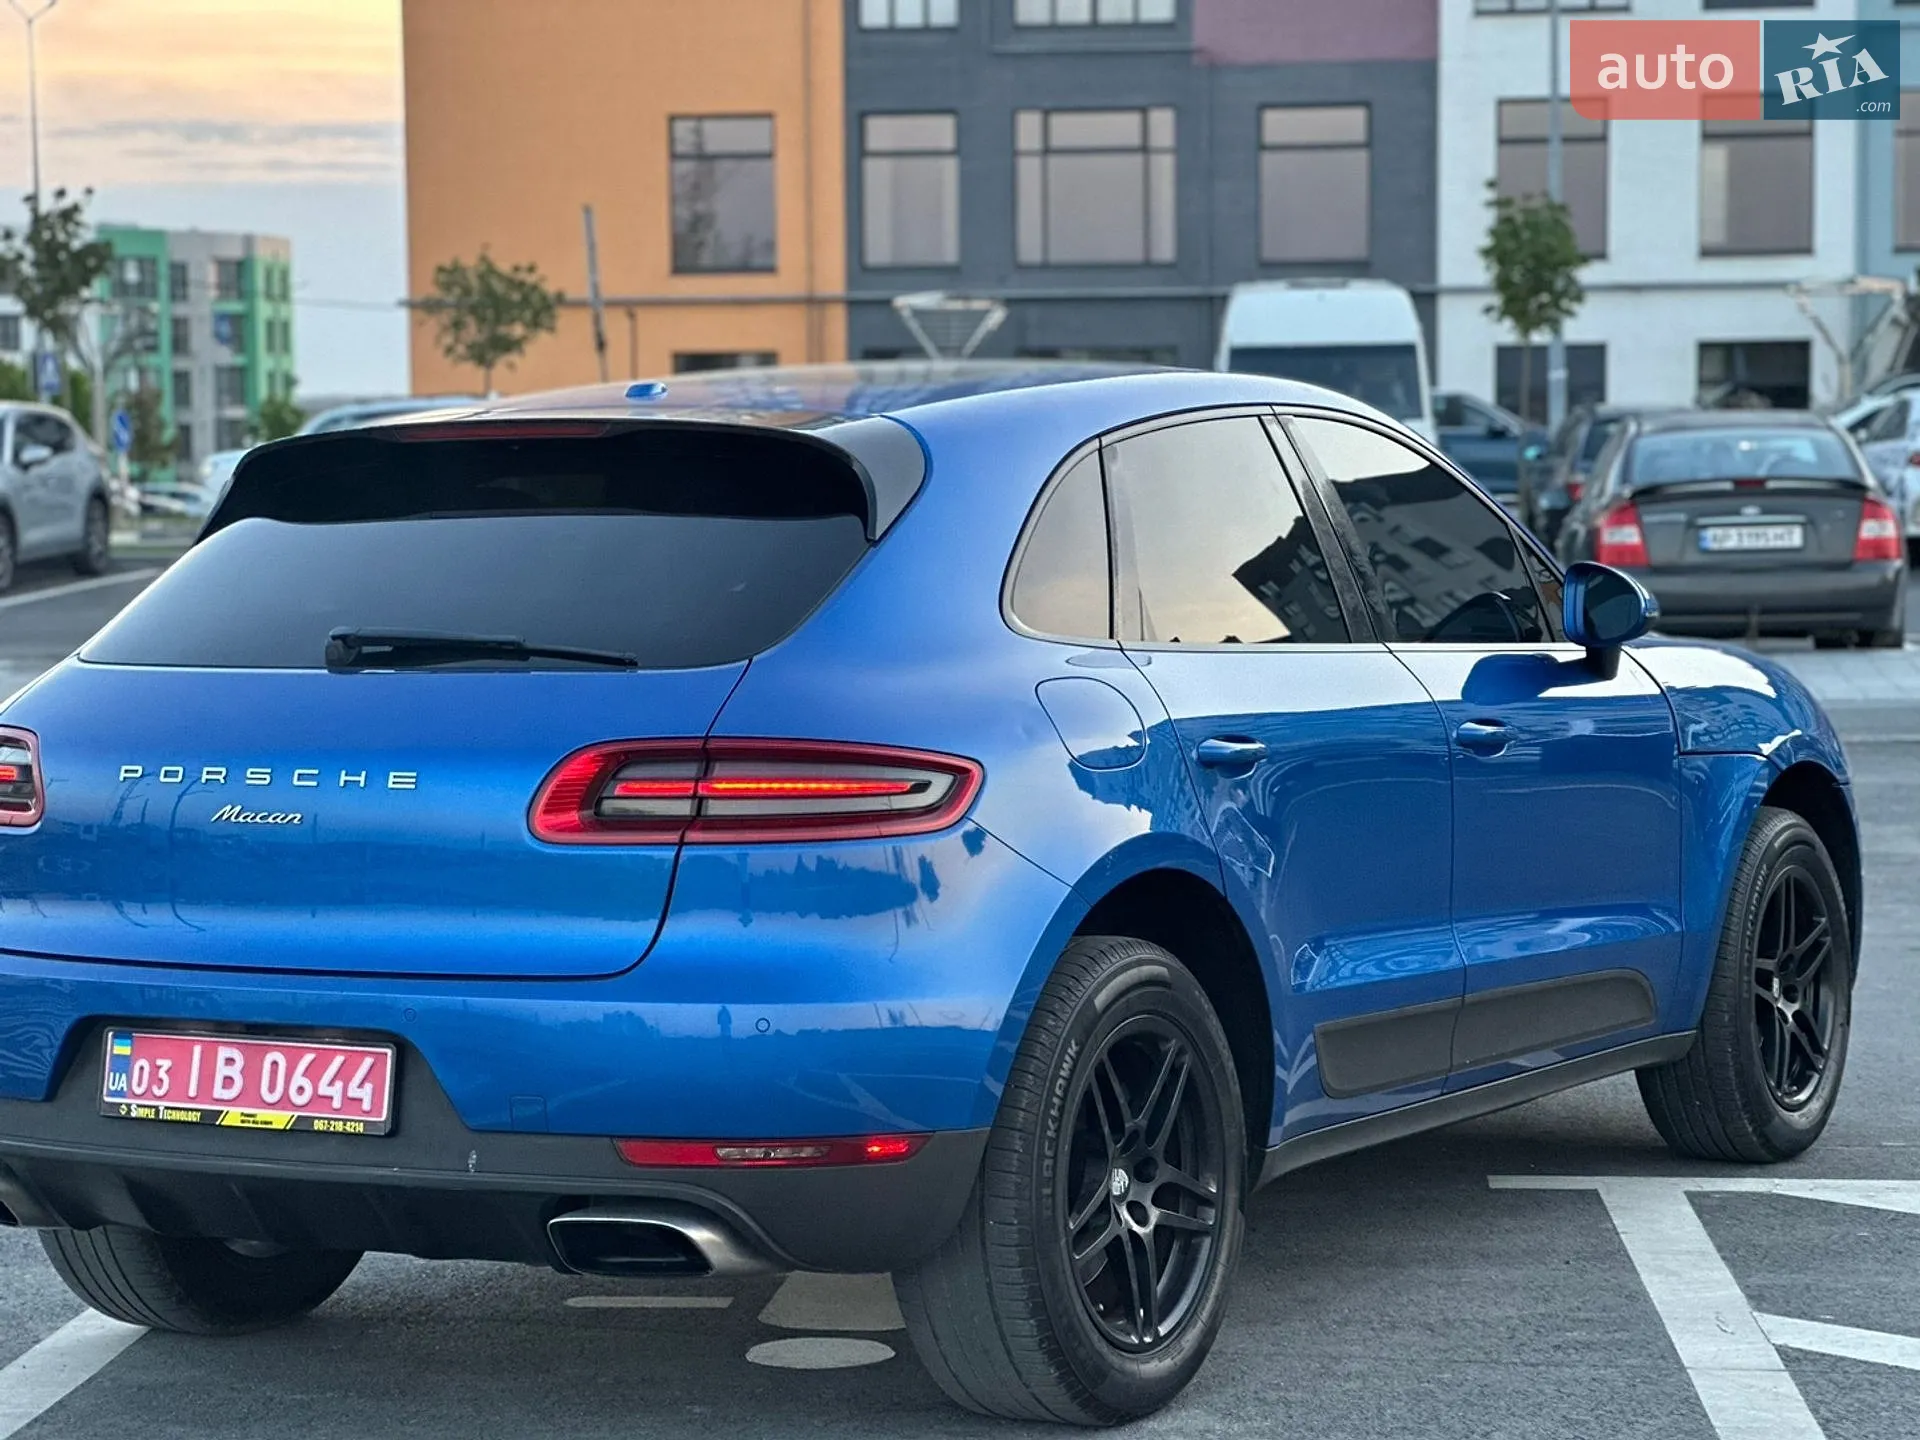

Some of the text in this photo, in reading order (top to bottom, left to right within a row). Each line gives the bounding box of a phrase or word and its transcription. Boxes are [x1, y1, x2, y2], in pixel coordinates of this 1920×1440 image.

[119, 765, 417, 789] PORSCHE
[211, 804, 303, 824] Macan
[108, 1072, 128, 1092] UA
[131, 1058, 173, 1098] 03
[260, 1050, 375, 1113] 0644
